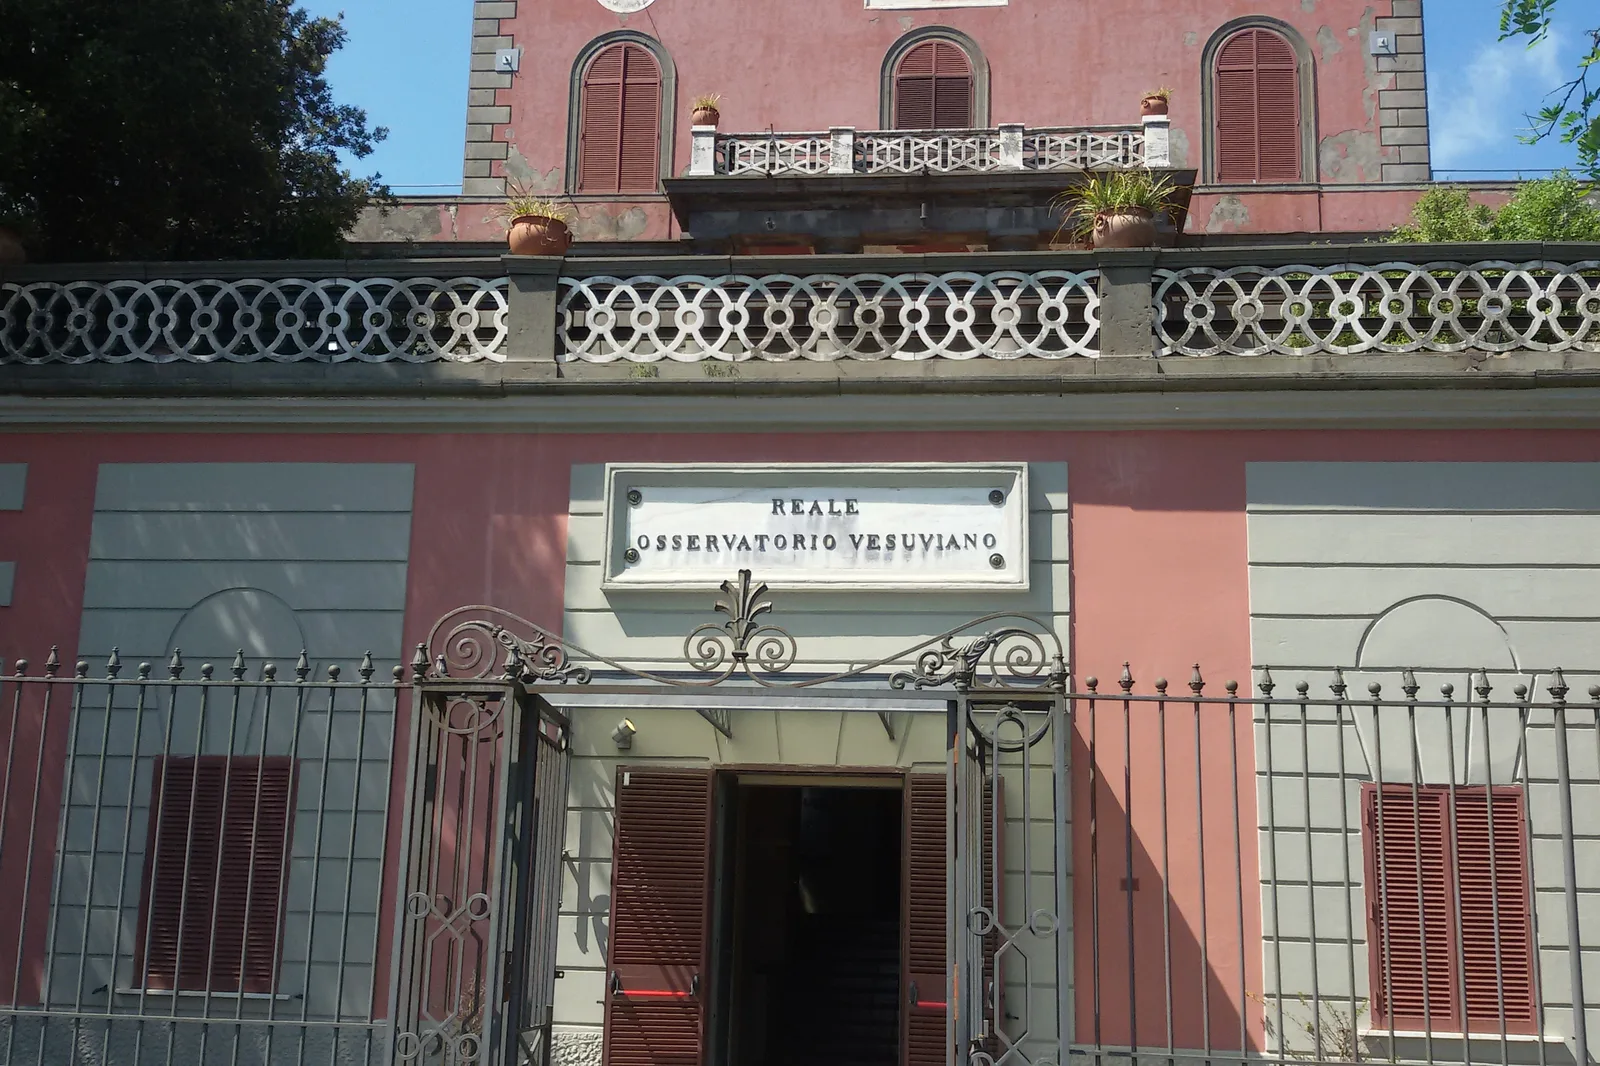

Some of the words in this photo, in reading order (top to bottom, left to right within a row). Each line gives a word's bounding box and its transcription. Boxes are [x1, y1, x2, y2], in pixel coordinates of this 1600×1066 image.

[771, 498, 860, 516] REALE
[636, 533, 837, 552] OSSERVATORIO
[848, 532, 998, 552] VESUVIANO
